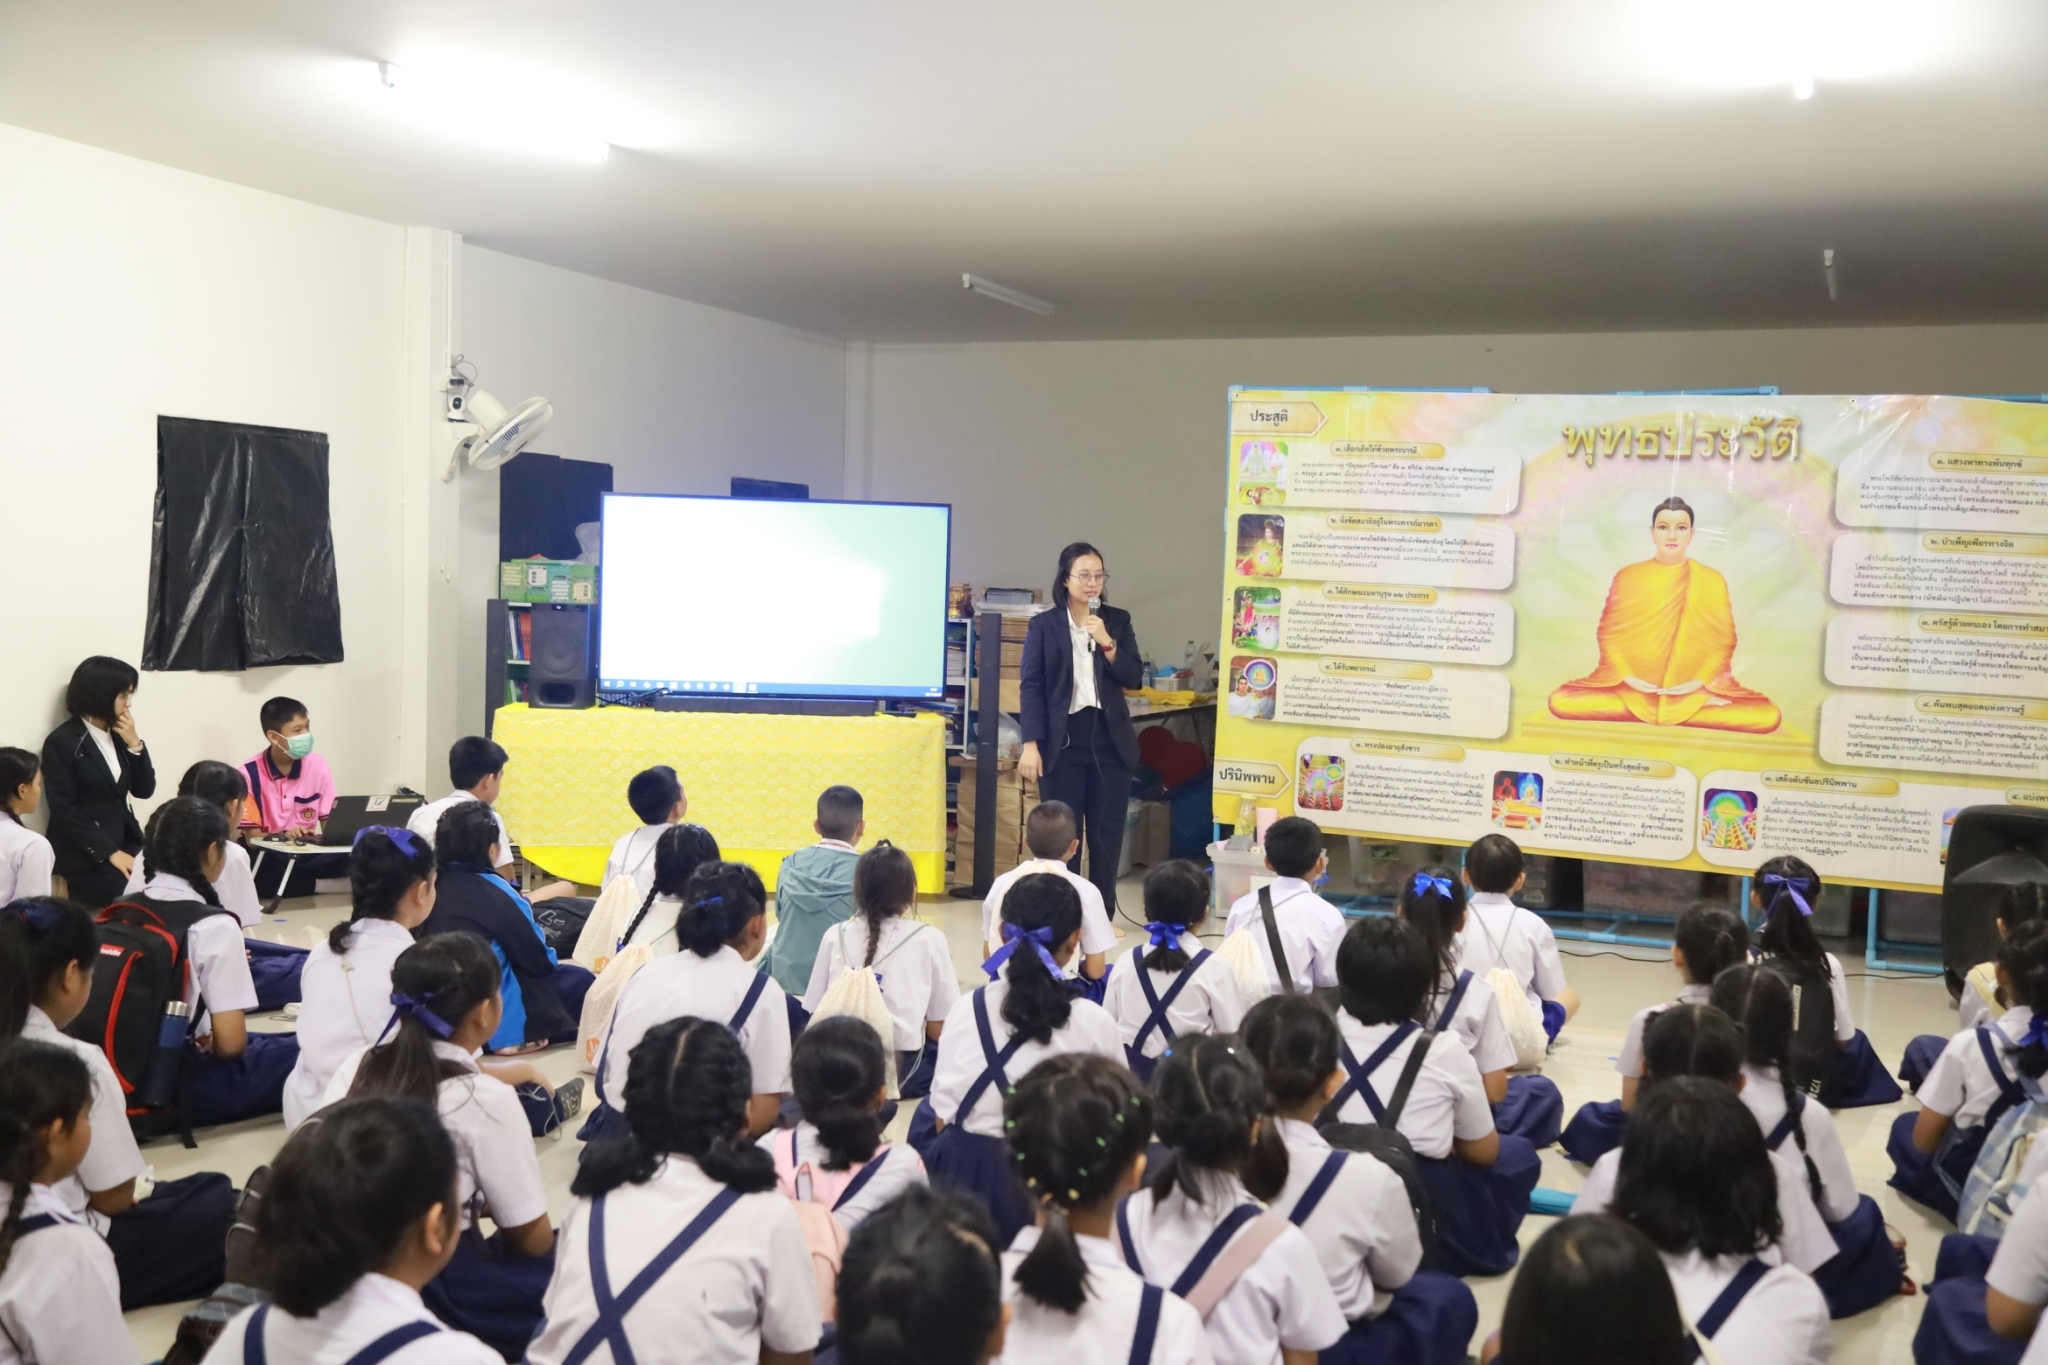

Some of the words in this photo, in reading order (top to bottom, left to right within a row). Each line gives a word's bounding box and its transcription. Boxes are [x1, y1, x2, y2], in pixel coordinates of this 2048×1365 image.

[1250, 408, 1289, 426] ประสูติ
[1562, 414, 1802, 469] พุทธประวัติ
[1947, 457, 2022, 469] แสวงหาทางพ้นทุกข์
[1941, 536, 2013, 549] บำเพ็ญเพียรทางจิต
[1404, 591, 1429, 599] ประการ
[1932, 617, 1991, 631] ตรัสรู้ด้วยตนเอง
[1333, 662, 1375, 672] ได้รับพยากรณ์
[1933, 699, 2024, 715] ค้นพบสุดยอดแห่งความรู้
[1564, 755, 1649, 773] ทำหน้าที่ครูเป็นครั้งสุดท้าย
[1219, 766, 1276, 786] ปรินิพพาน
[1775, 773, 1857, 788] เสด็จดับขันธปรินิพพาน
